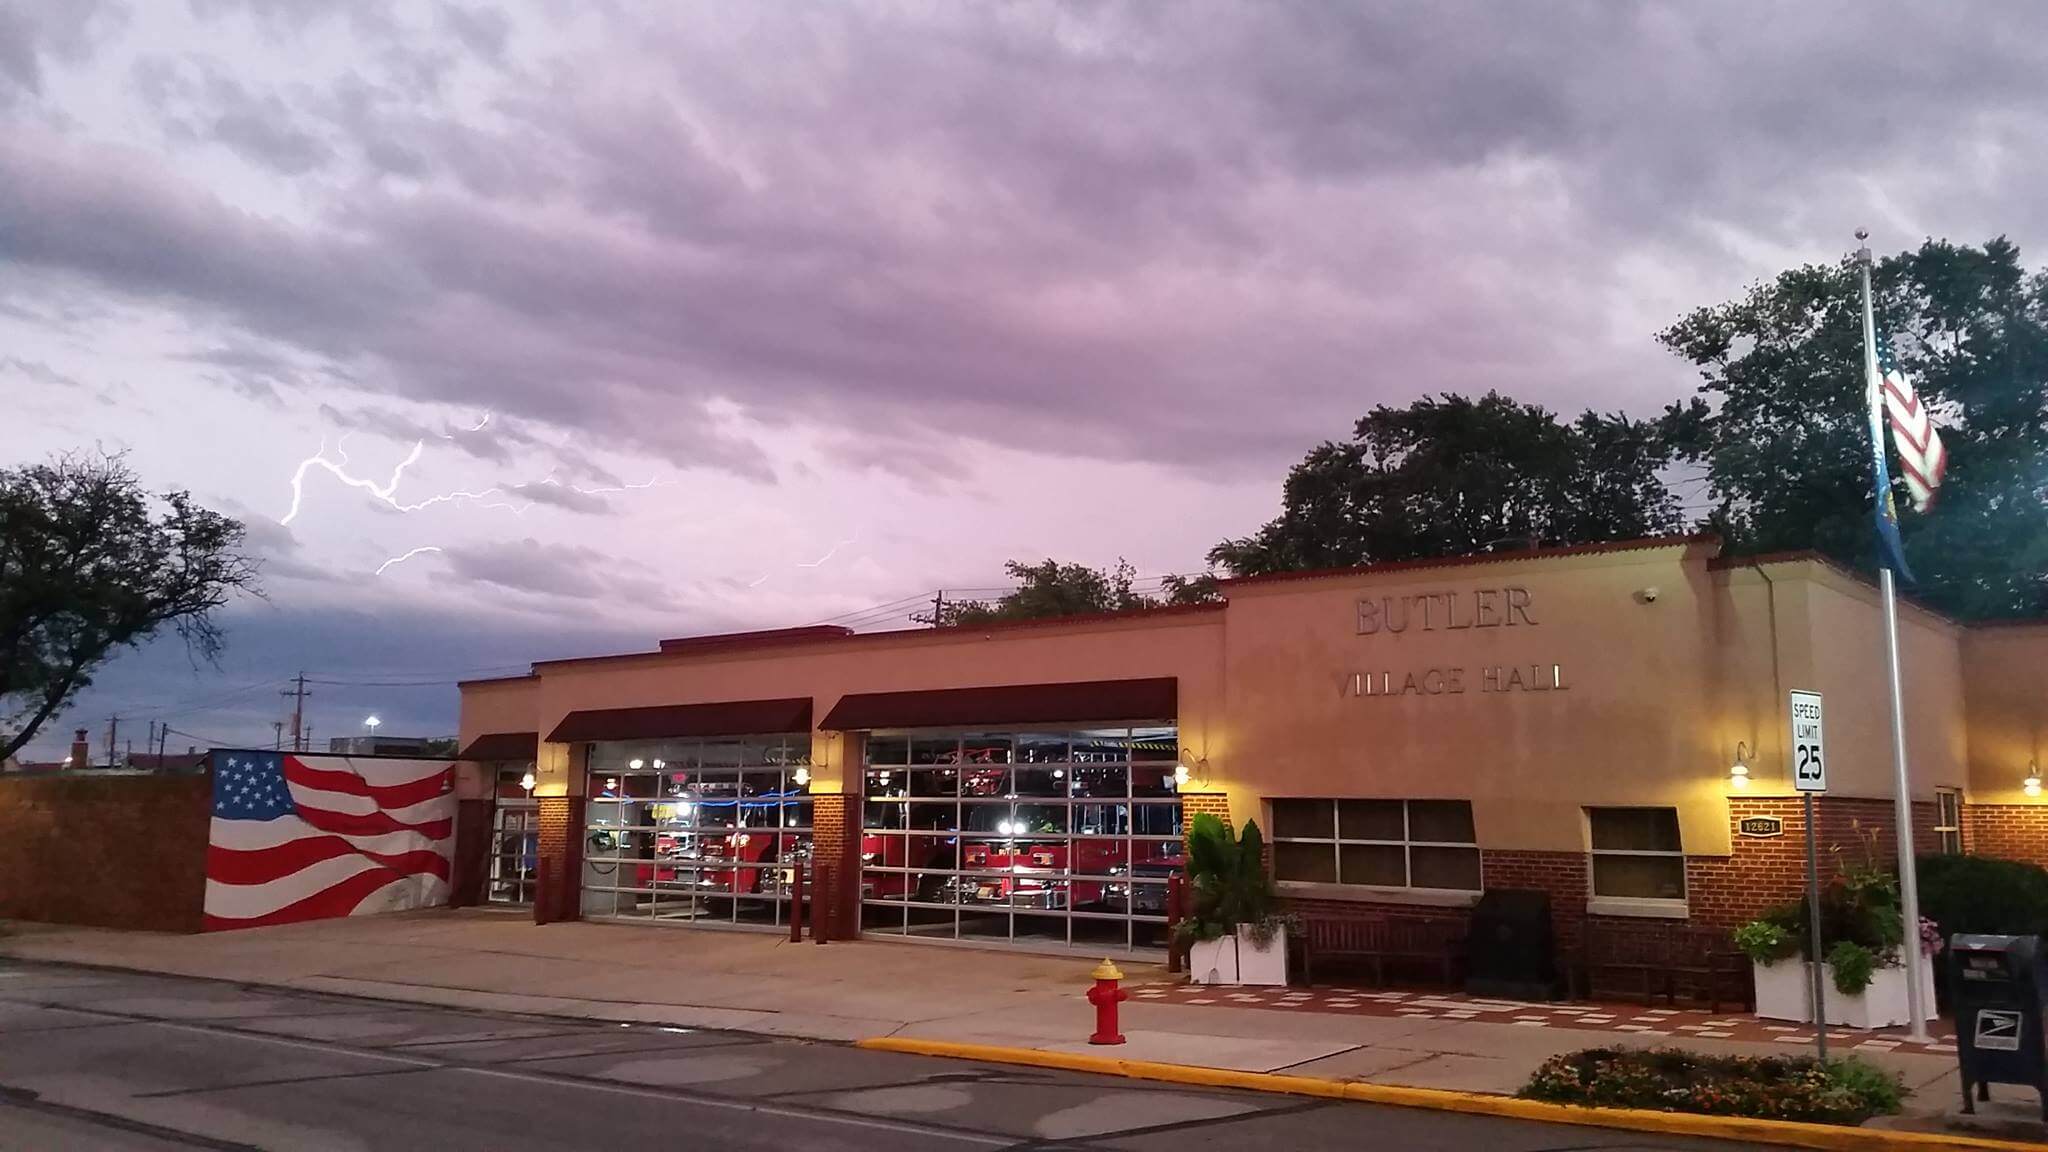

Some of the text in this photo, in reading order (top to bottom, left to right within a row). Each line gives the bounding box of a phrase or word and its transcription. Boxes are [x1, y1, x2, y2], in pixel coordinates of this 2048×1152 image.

[1355, 584, 1540, 636] BUTLER
[1333, 663, 1571, 698] VILLAGE HALL
[1793, 703, 1821, 720] SPEED
[1797, 724, 1818, 740] LIMIT
[1797, 744, 1822, 780] 25
[1745, 821, 1776, 832] 12621
